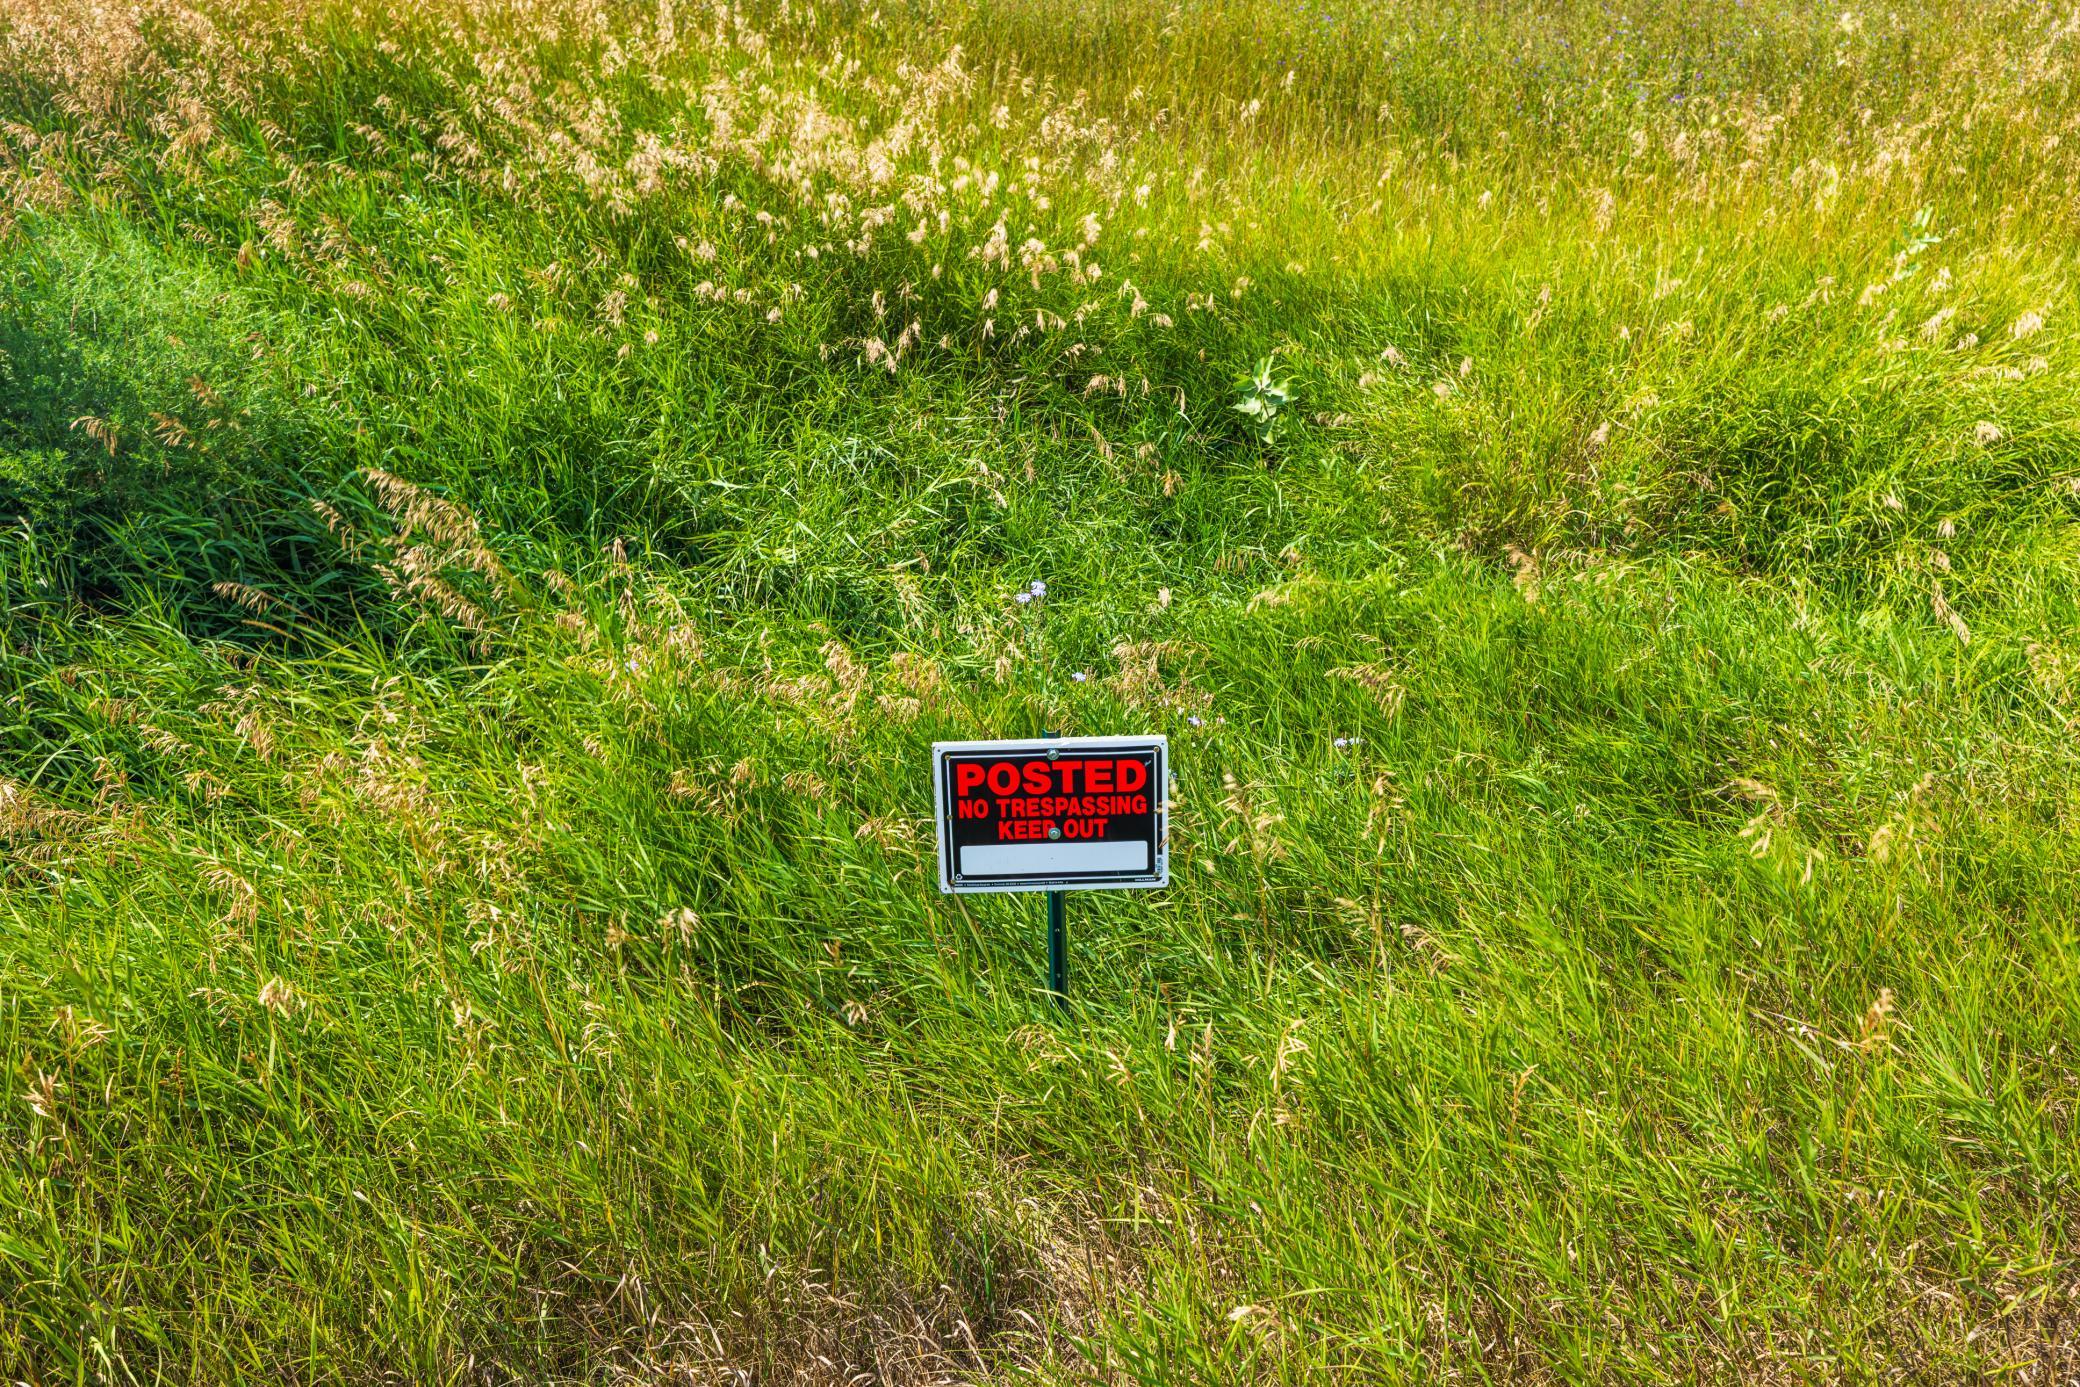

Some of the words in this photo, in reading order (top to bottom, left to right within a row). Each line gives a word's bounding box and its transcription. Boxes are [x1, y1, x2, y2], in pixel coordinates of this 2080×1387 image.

[956, 759, 1147, 797] POSTED
[958, 798, 989, 819] NO
[995, 795, 1148, 819] TRESPASSING
[998, 818, 1057, 840] KEEP
[1063, 817, 1109, 839] OUT
